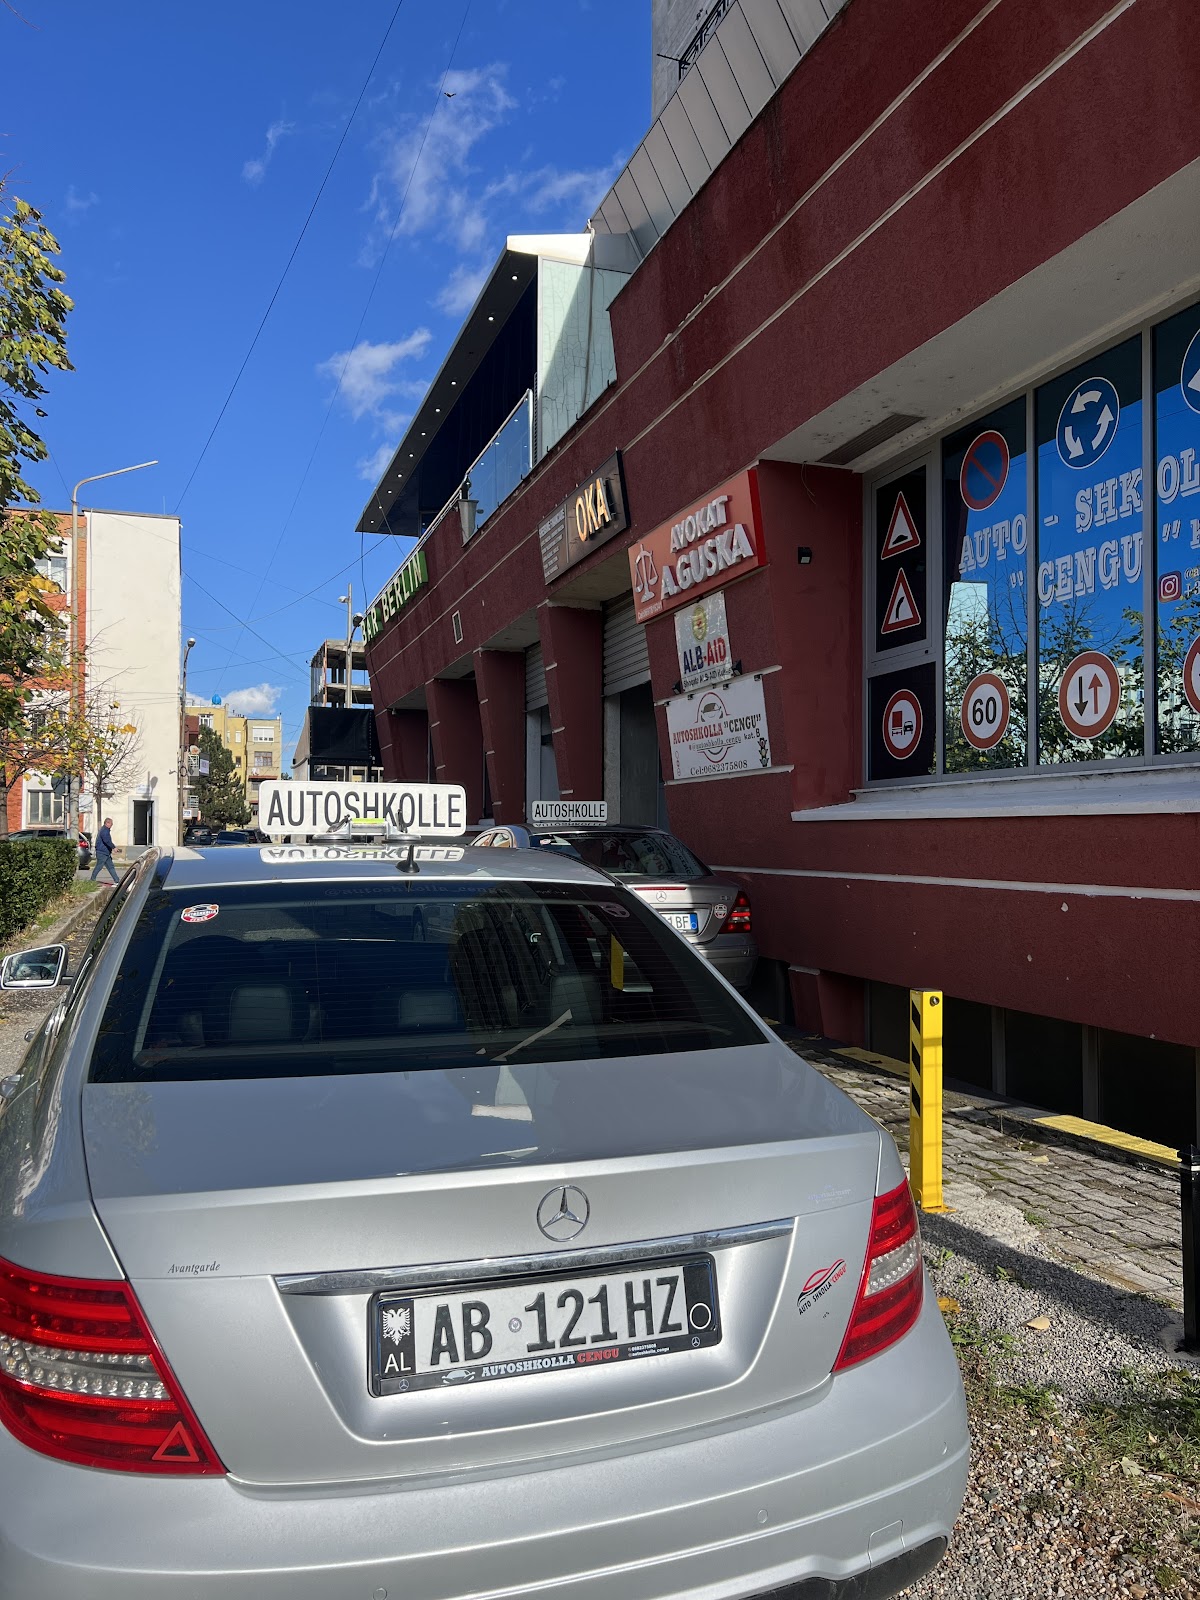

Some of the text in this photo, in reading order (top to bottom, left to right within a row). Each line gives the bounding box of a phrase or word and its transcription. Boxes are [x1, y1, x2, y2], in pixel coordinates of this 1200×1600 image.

[575, 477, 612, 542] OKA
[670, 494, 728, 553] AVOKAT
[958, 513, 1028, 574] AUTO
[361, 551, 426, 646] BAR BERLIN
[683, 636, 727, 675] ALB-AID
[972, 696, 997, 726] 60
[673, 722, 724, 745] AUTOSHKOLLA
[267, 789, 462, 828] AUTOSHKOLLE
[534, 803, 605, 818] AUTOSHKOLLE
[167, 1261, 221, 1275] Avantgarde
[798, 1300, 812, 1316] AUTO
[812, 1281, 833, 1303] SHKOLLA
[430, 1300, 493, 1367] AB
[384, 1354, 411, 1375] AL
[481, 1348, 620, 1378] AUTOSHKOLLA CENGU
